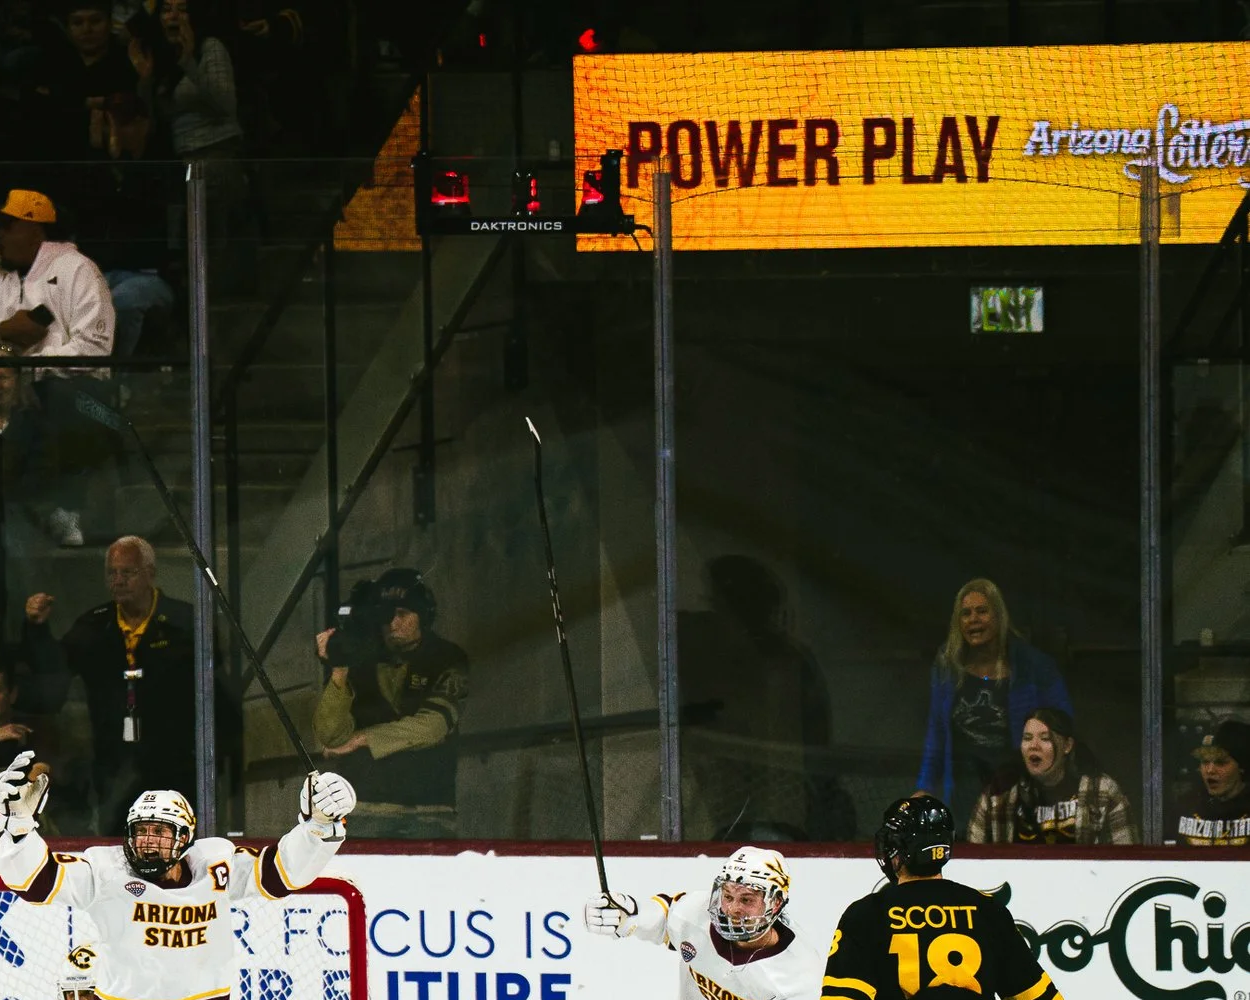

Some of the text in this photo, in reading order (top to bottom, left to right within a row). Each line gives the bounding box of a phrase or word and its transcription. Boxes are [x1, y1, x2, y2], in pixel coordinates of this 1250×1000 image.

[626, 103, 1250, 190] POWER PLAY Arizona Lotter
[470, 221, 563, 231] DAKTRONICS
[931, 846, 945, 861] 18
[215, 866, 228, 886] C
[132, 900, 218, 926] ARIZONA
[888, 904, 978, 931] SCOTT
[143, 926, 209, 949] STATE
[283, 908, 496, 959] FOCUS
[525, 911, 573, 960] IS
[888, 933, 983, 1000] 18
